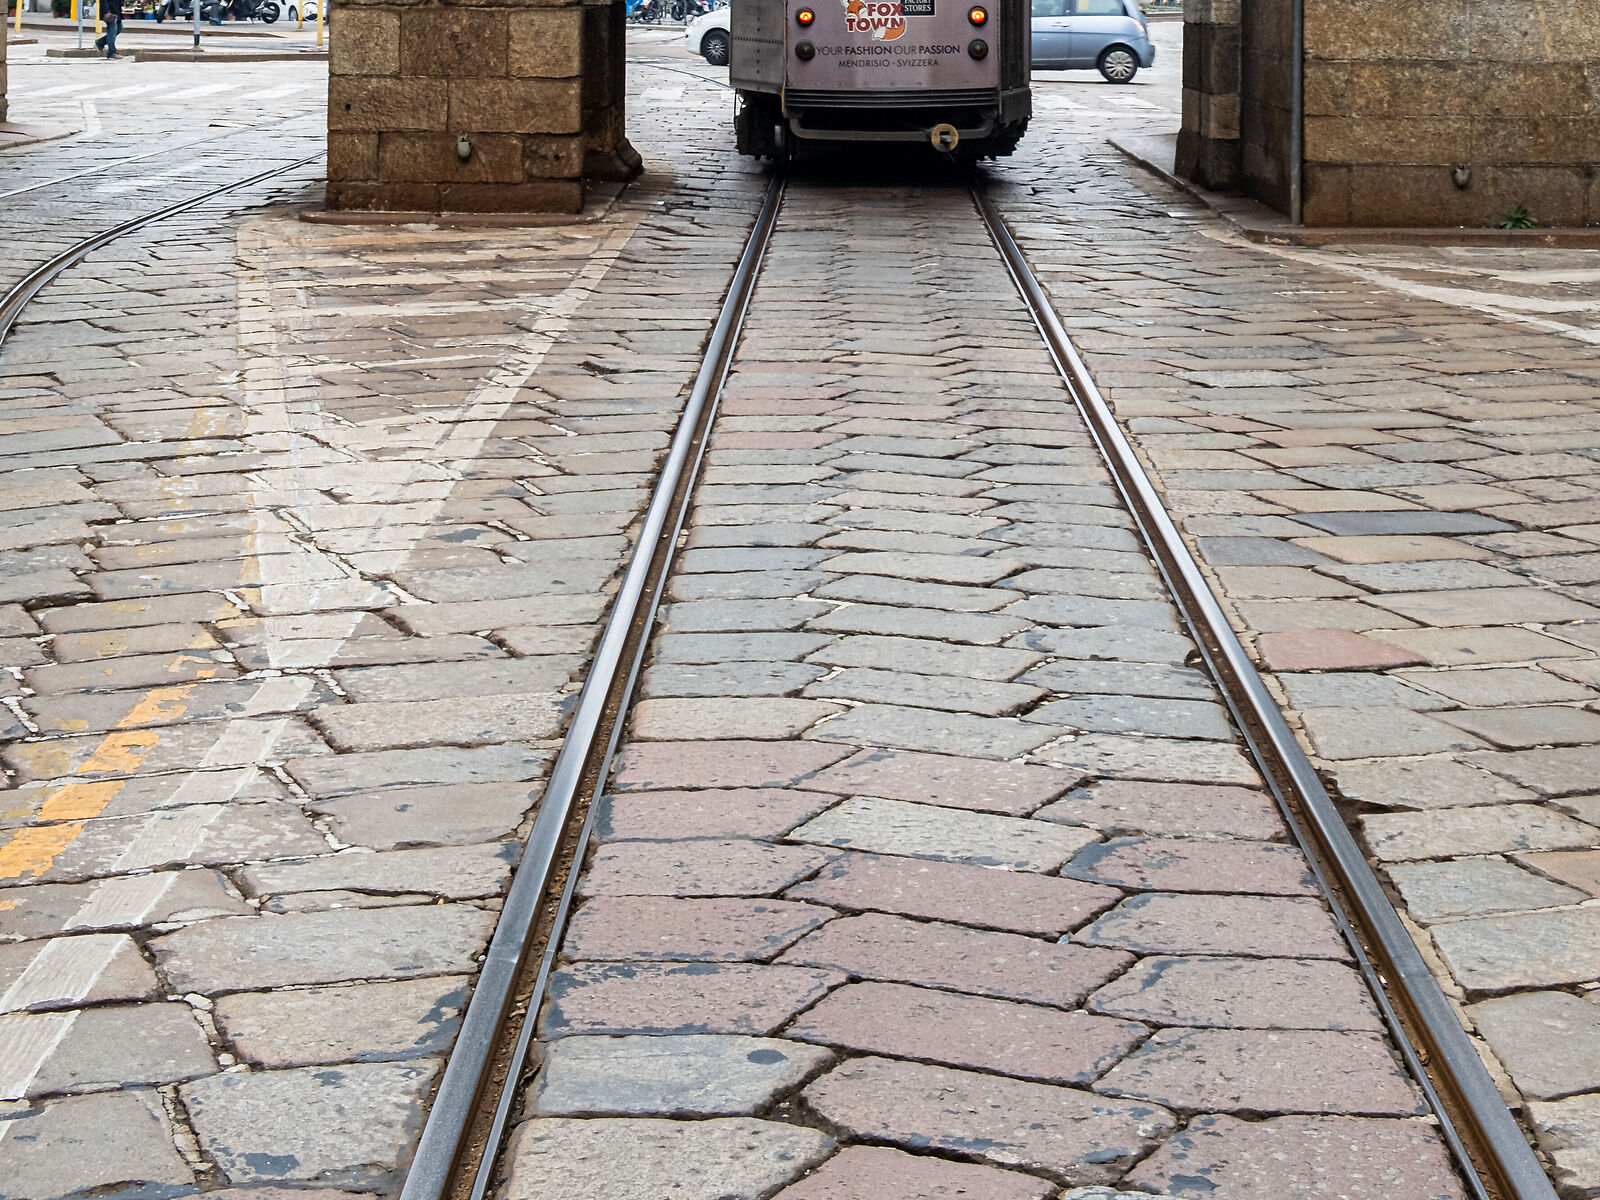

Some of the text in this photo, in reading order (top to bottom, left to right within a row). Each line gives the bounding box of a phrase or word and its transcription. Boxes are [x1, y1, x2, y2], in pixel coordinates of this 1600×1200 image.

[867, 3, 904, 16] FOX
[904, 4, 932, 12] STORES
[846, 18, 904, 32] TOWN
[816, 45, 960, 55] YOUR FASHION OUR PASSION
[838, 58, 939, 68] MENDRISIO SVIZZERA
